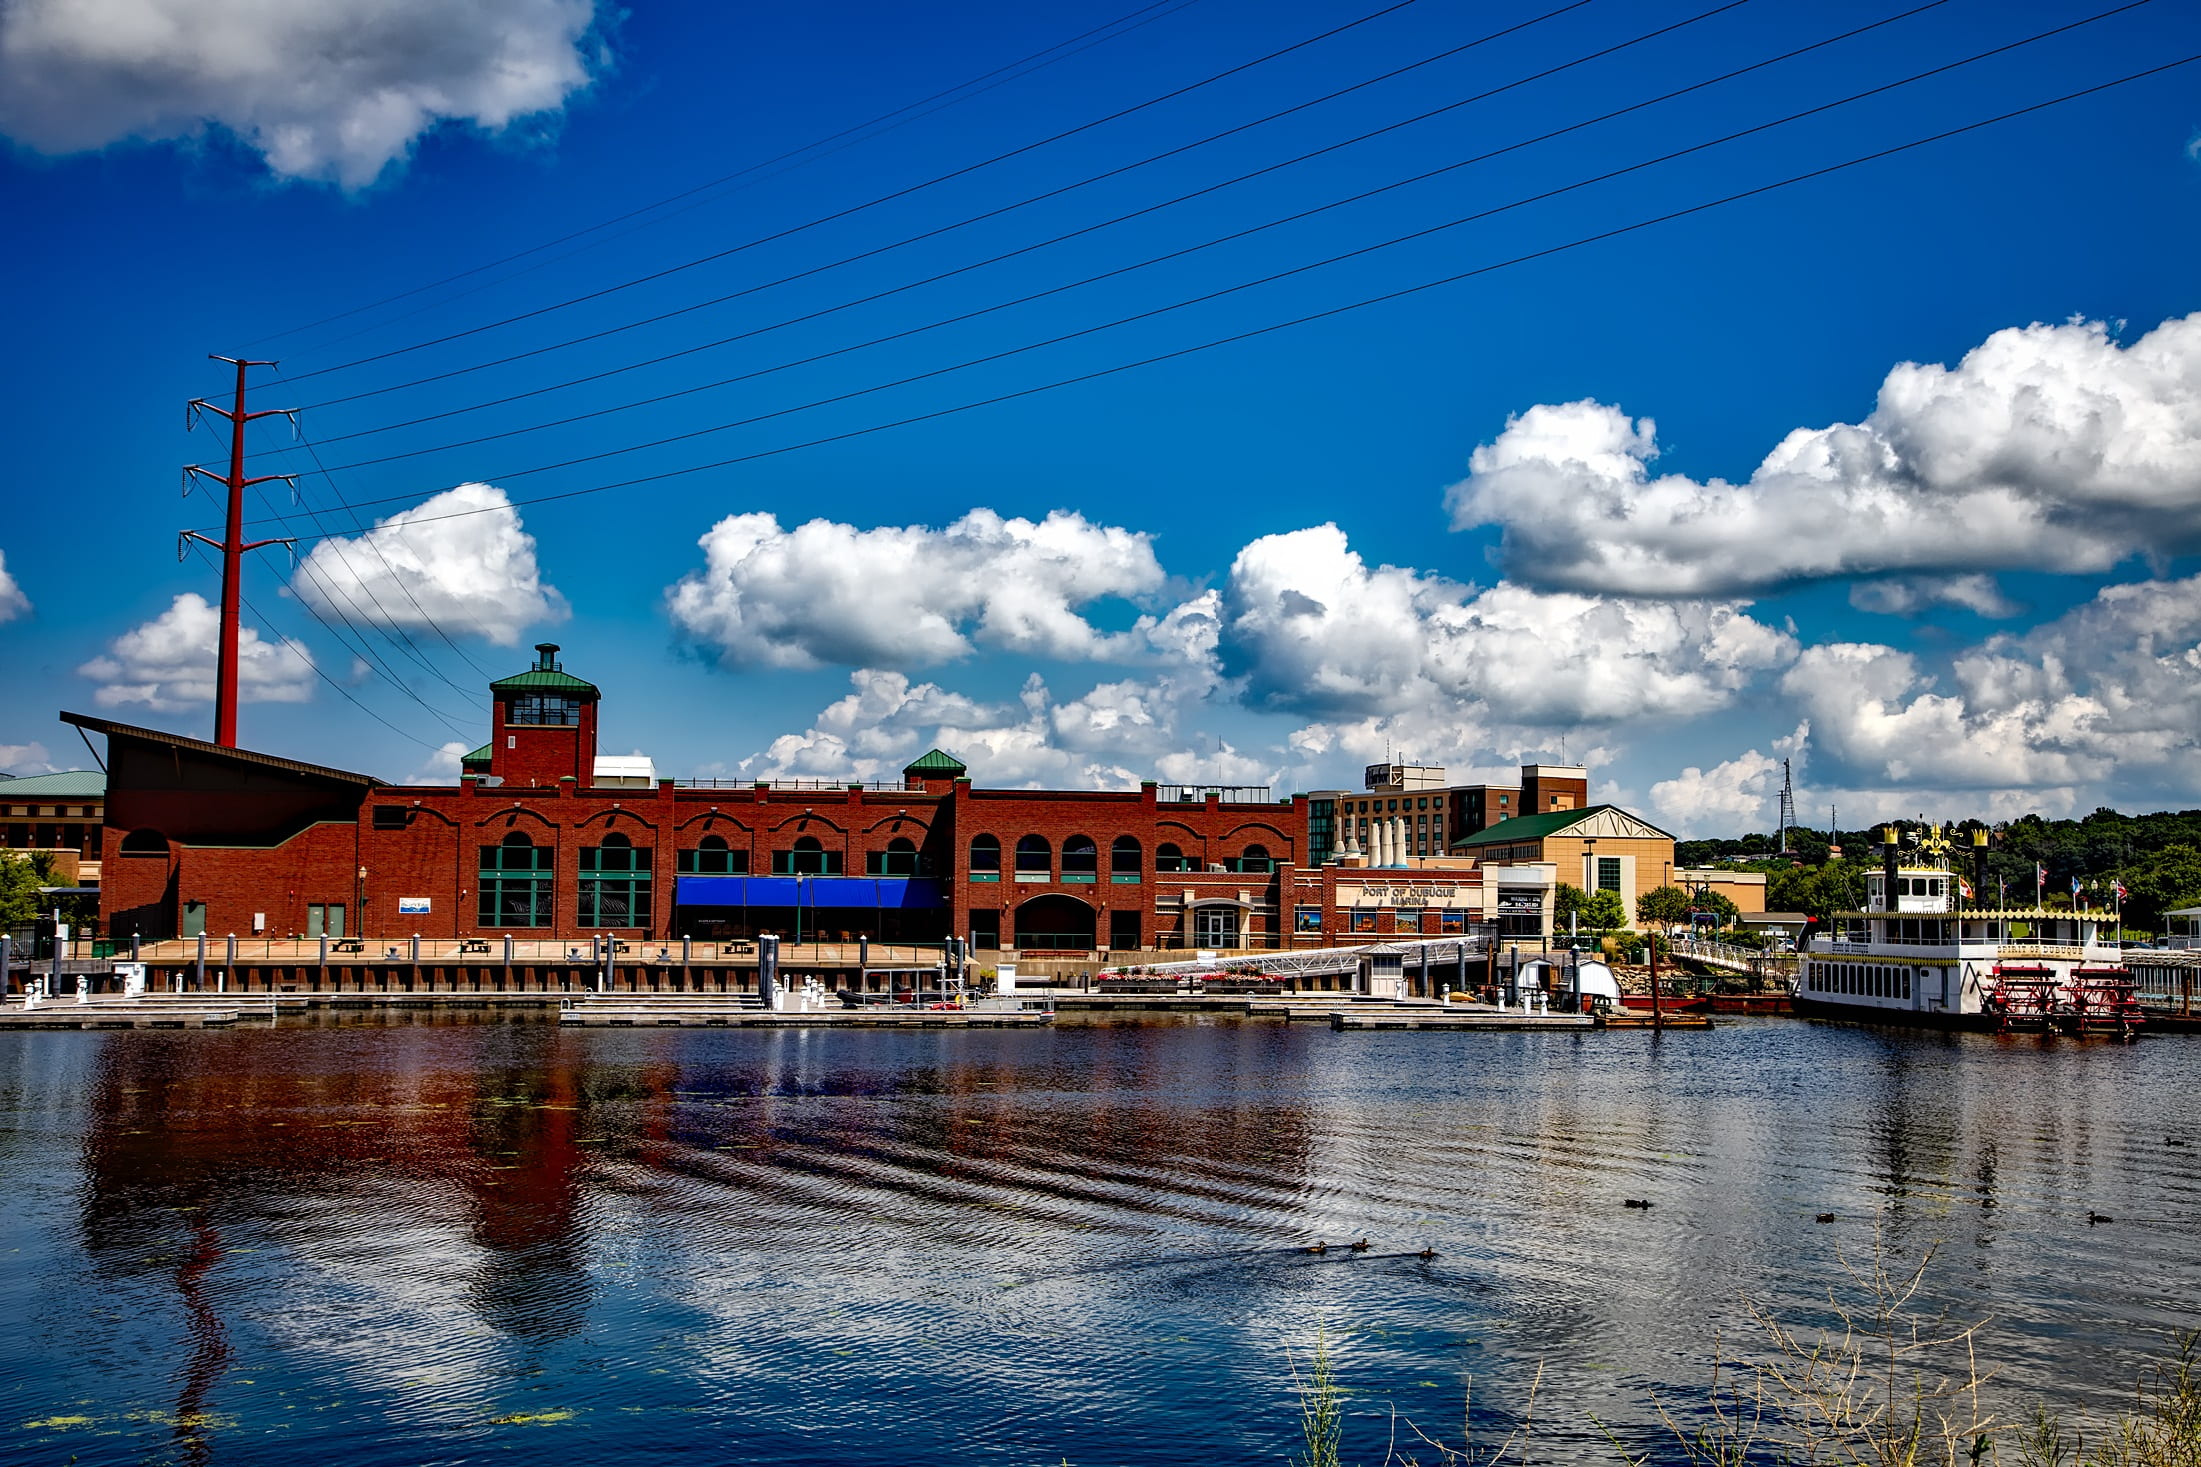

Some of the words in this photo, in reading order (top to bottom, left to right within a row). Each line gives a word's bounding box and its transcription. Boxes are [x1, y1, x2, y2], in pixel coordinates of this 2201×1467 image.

[1933, 839, 1940, 848] D
[1362, 887, 1388, 897] PORT
[1392, 888, 1406, 897] OF
[1409, 888, 1456, 898] DUBUQUE
[1390, 897, 1427, 906] MARINA
[1997, 945, 2027, 953] SPIRIT
[2030, 945, 2040, 953] OF
[2043, 946, 2084, 956] DUBUQUE
